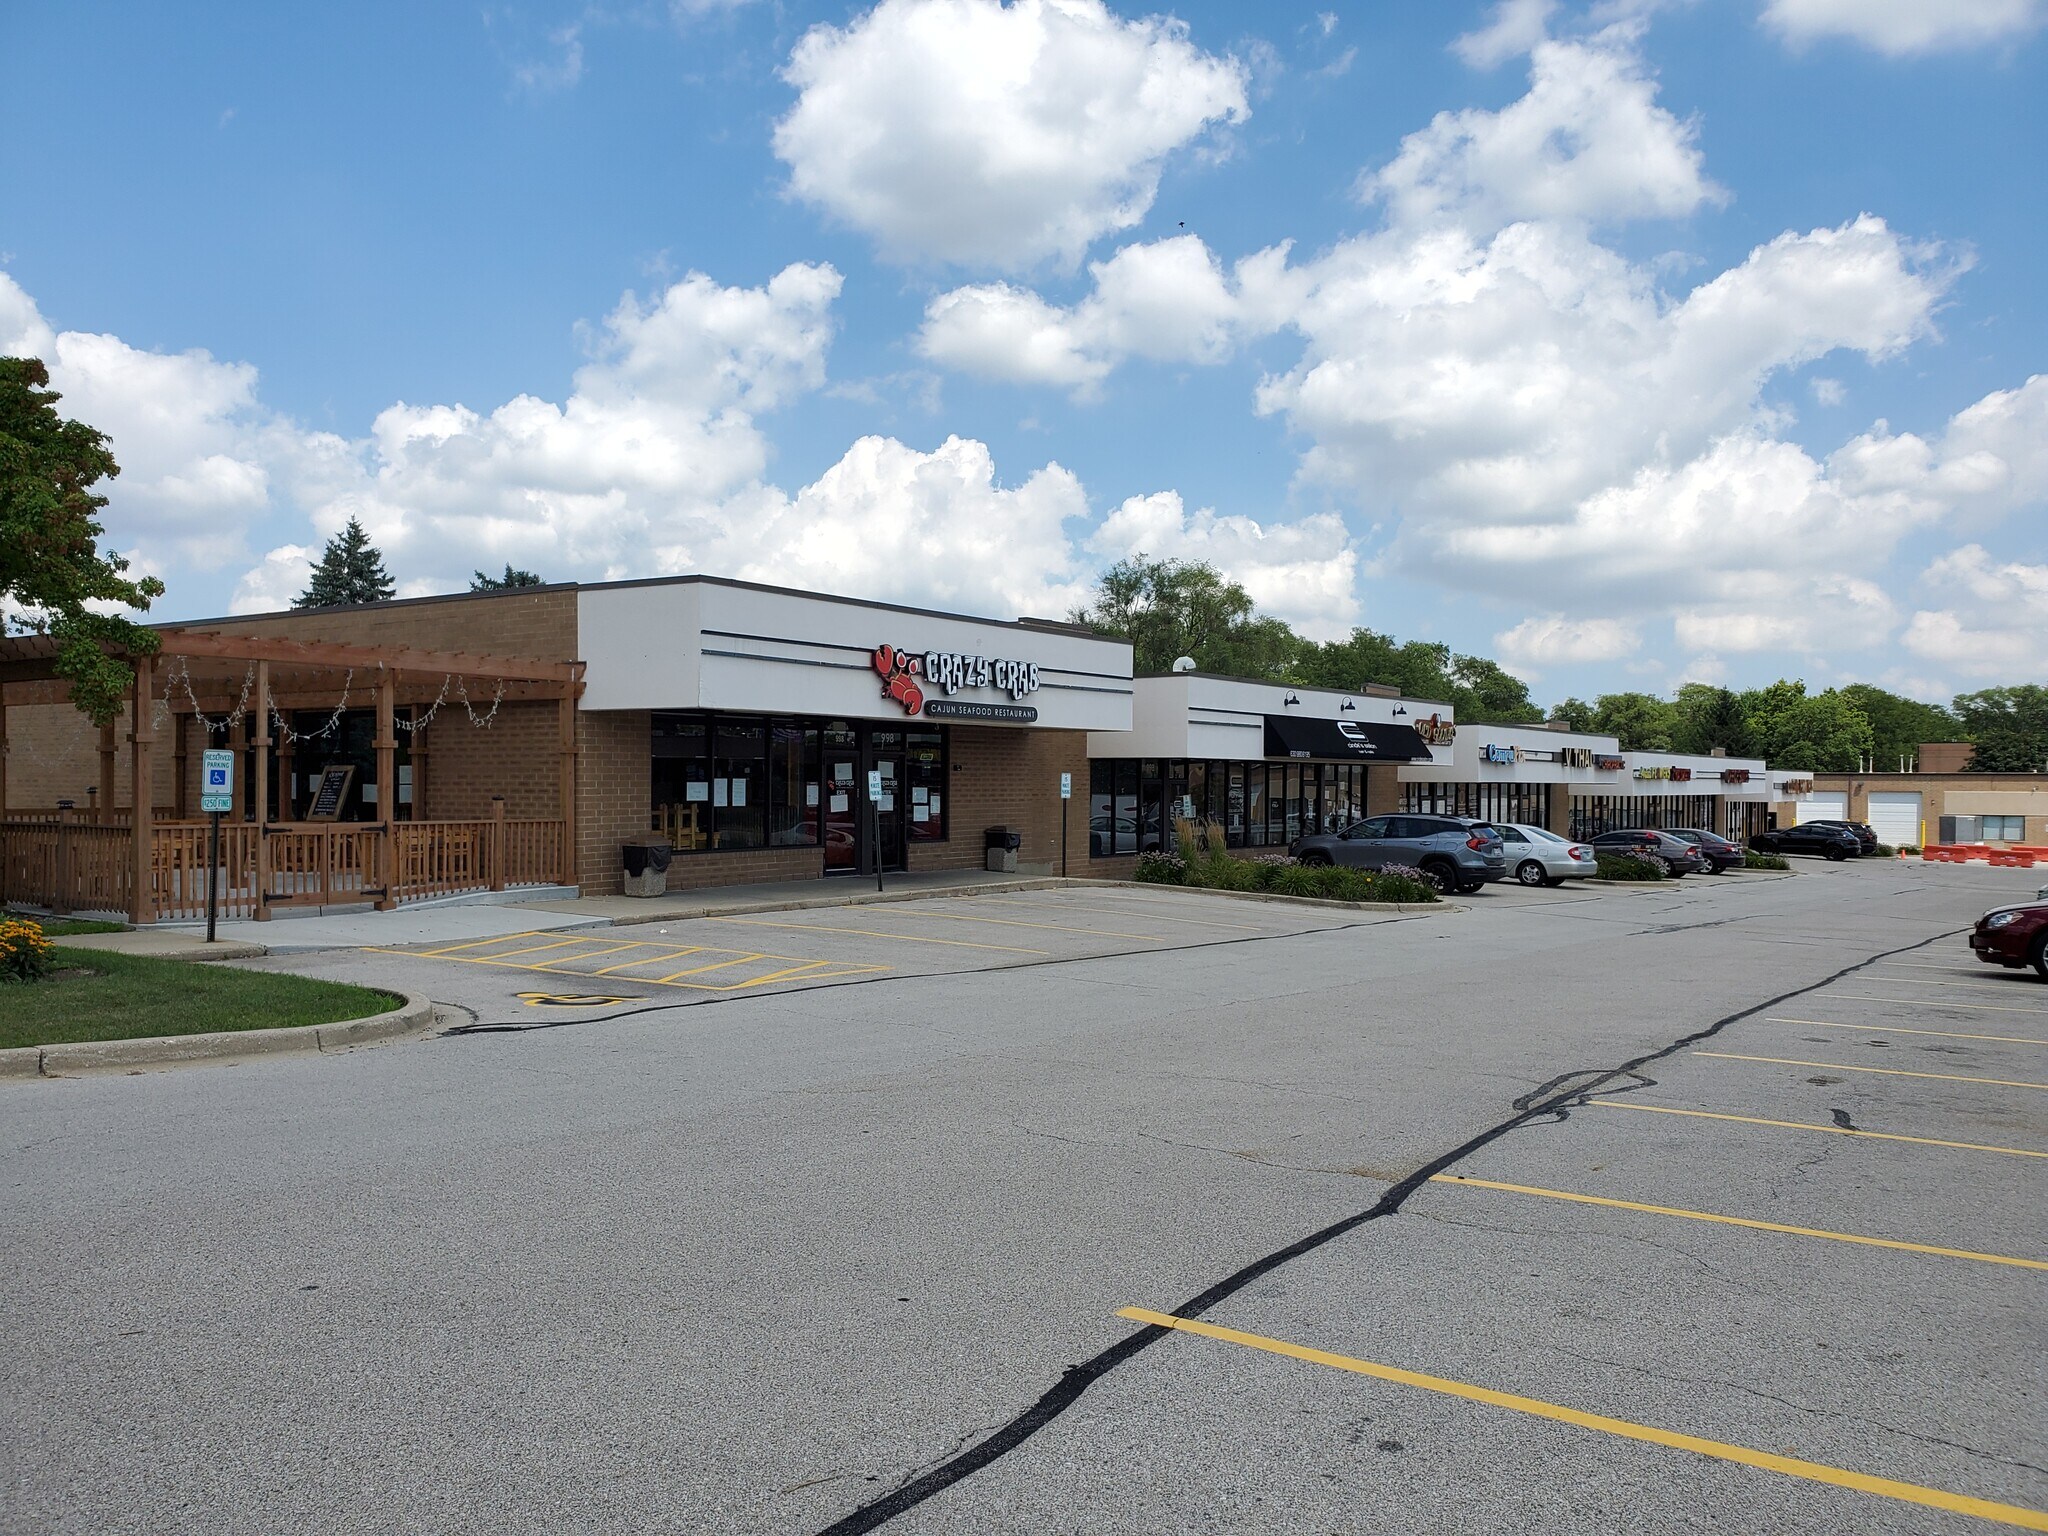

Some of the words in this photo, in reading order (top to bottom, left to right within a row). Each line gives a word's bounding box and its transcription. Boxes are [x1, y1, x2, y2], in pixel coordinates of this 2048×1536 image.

[924, 651, 989, 695] CRAZY
[994, 659, 1040, 700] CRAB
[930, 704, 956, 714] CAJUN
[958, 706, 992, 716] SEAFOOD
[994, 708, 1036, 718] RESTAURANT
[881, 733, 895, 743] 998
[206, 753, 231, 761] RESERVED
[204, 799, 217, 807] $250
[218, 800, 230, 808] FINE
